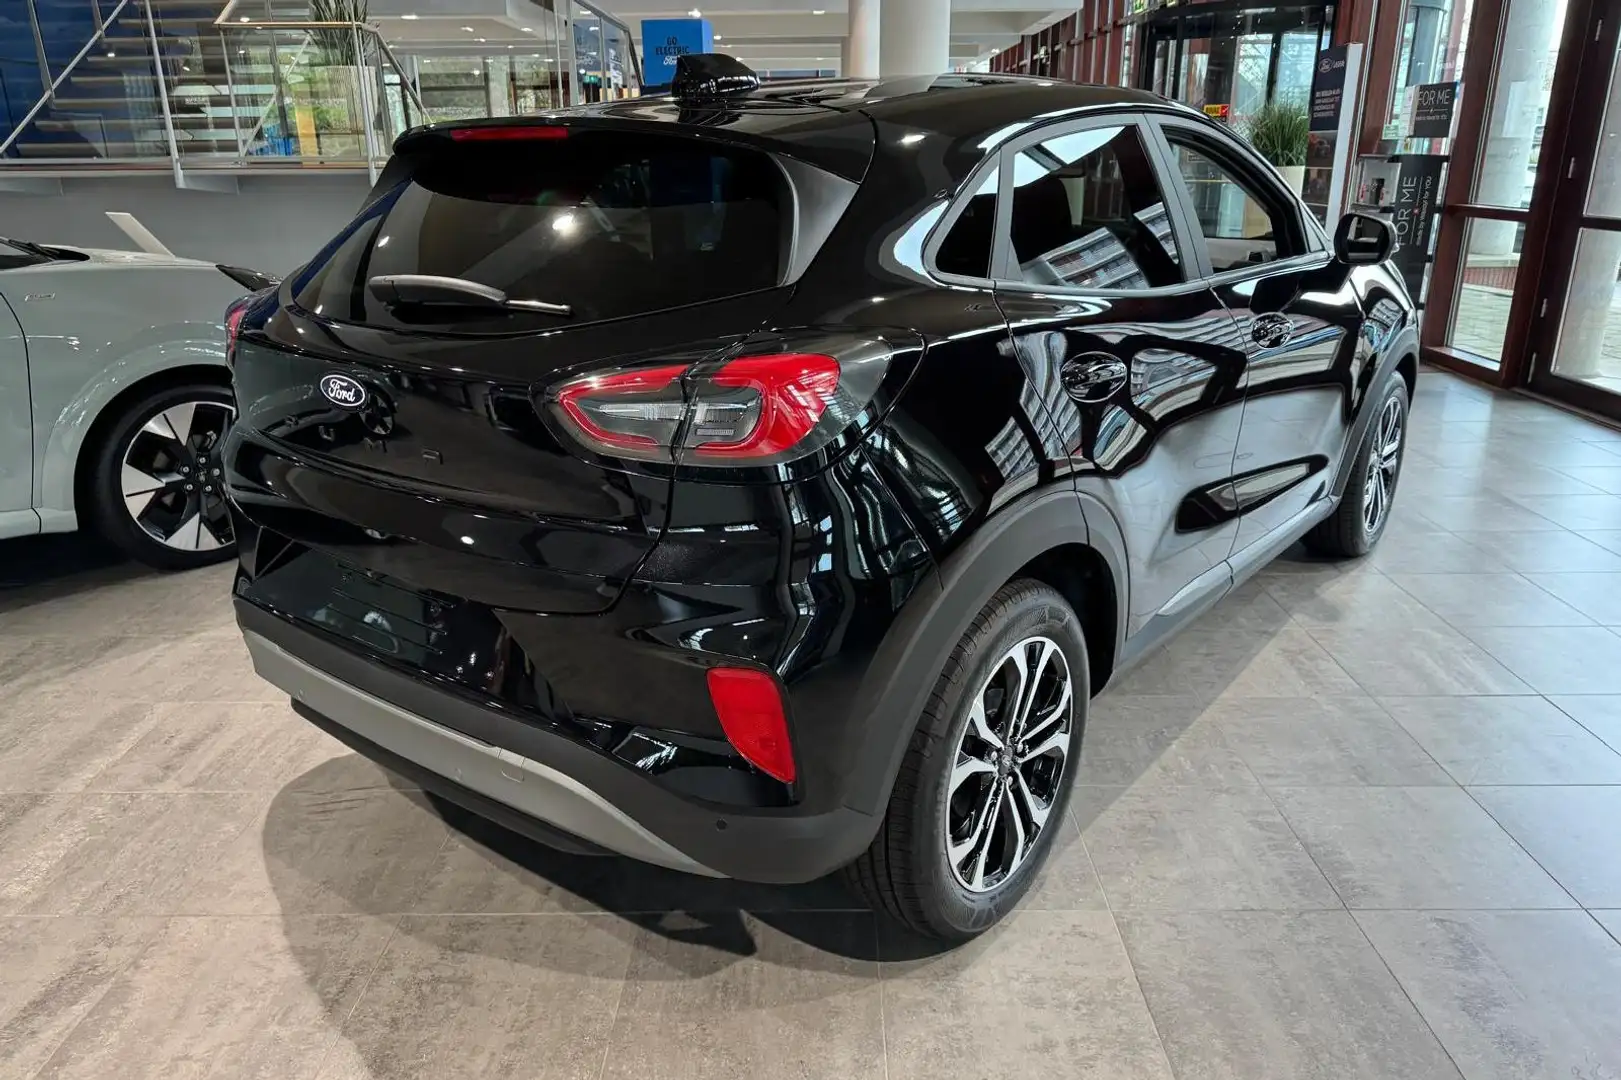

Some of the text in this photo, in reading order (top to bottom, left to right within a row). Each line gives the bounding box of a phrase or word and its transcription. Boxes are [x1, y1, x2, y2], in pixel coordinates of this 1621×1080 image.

[666, 36, 678, 45] GO
[655, 46, 690, 55] ELECTRIC
[1418, 88, 1452, 106] FOR ME
[1396, 176, 1417, 246] FOR ME
[328, 378, 356, 402] Ford
